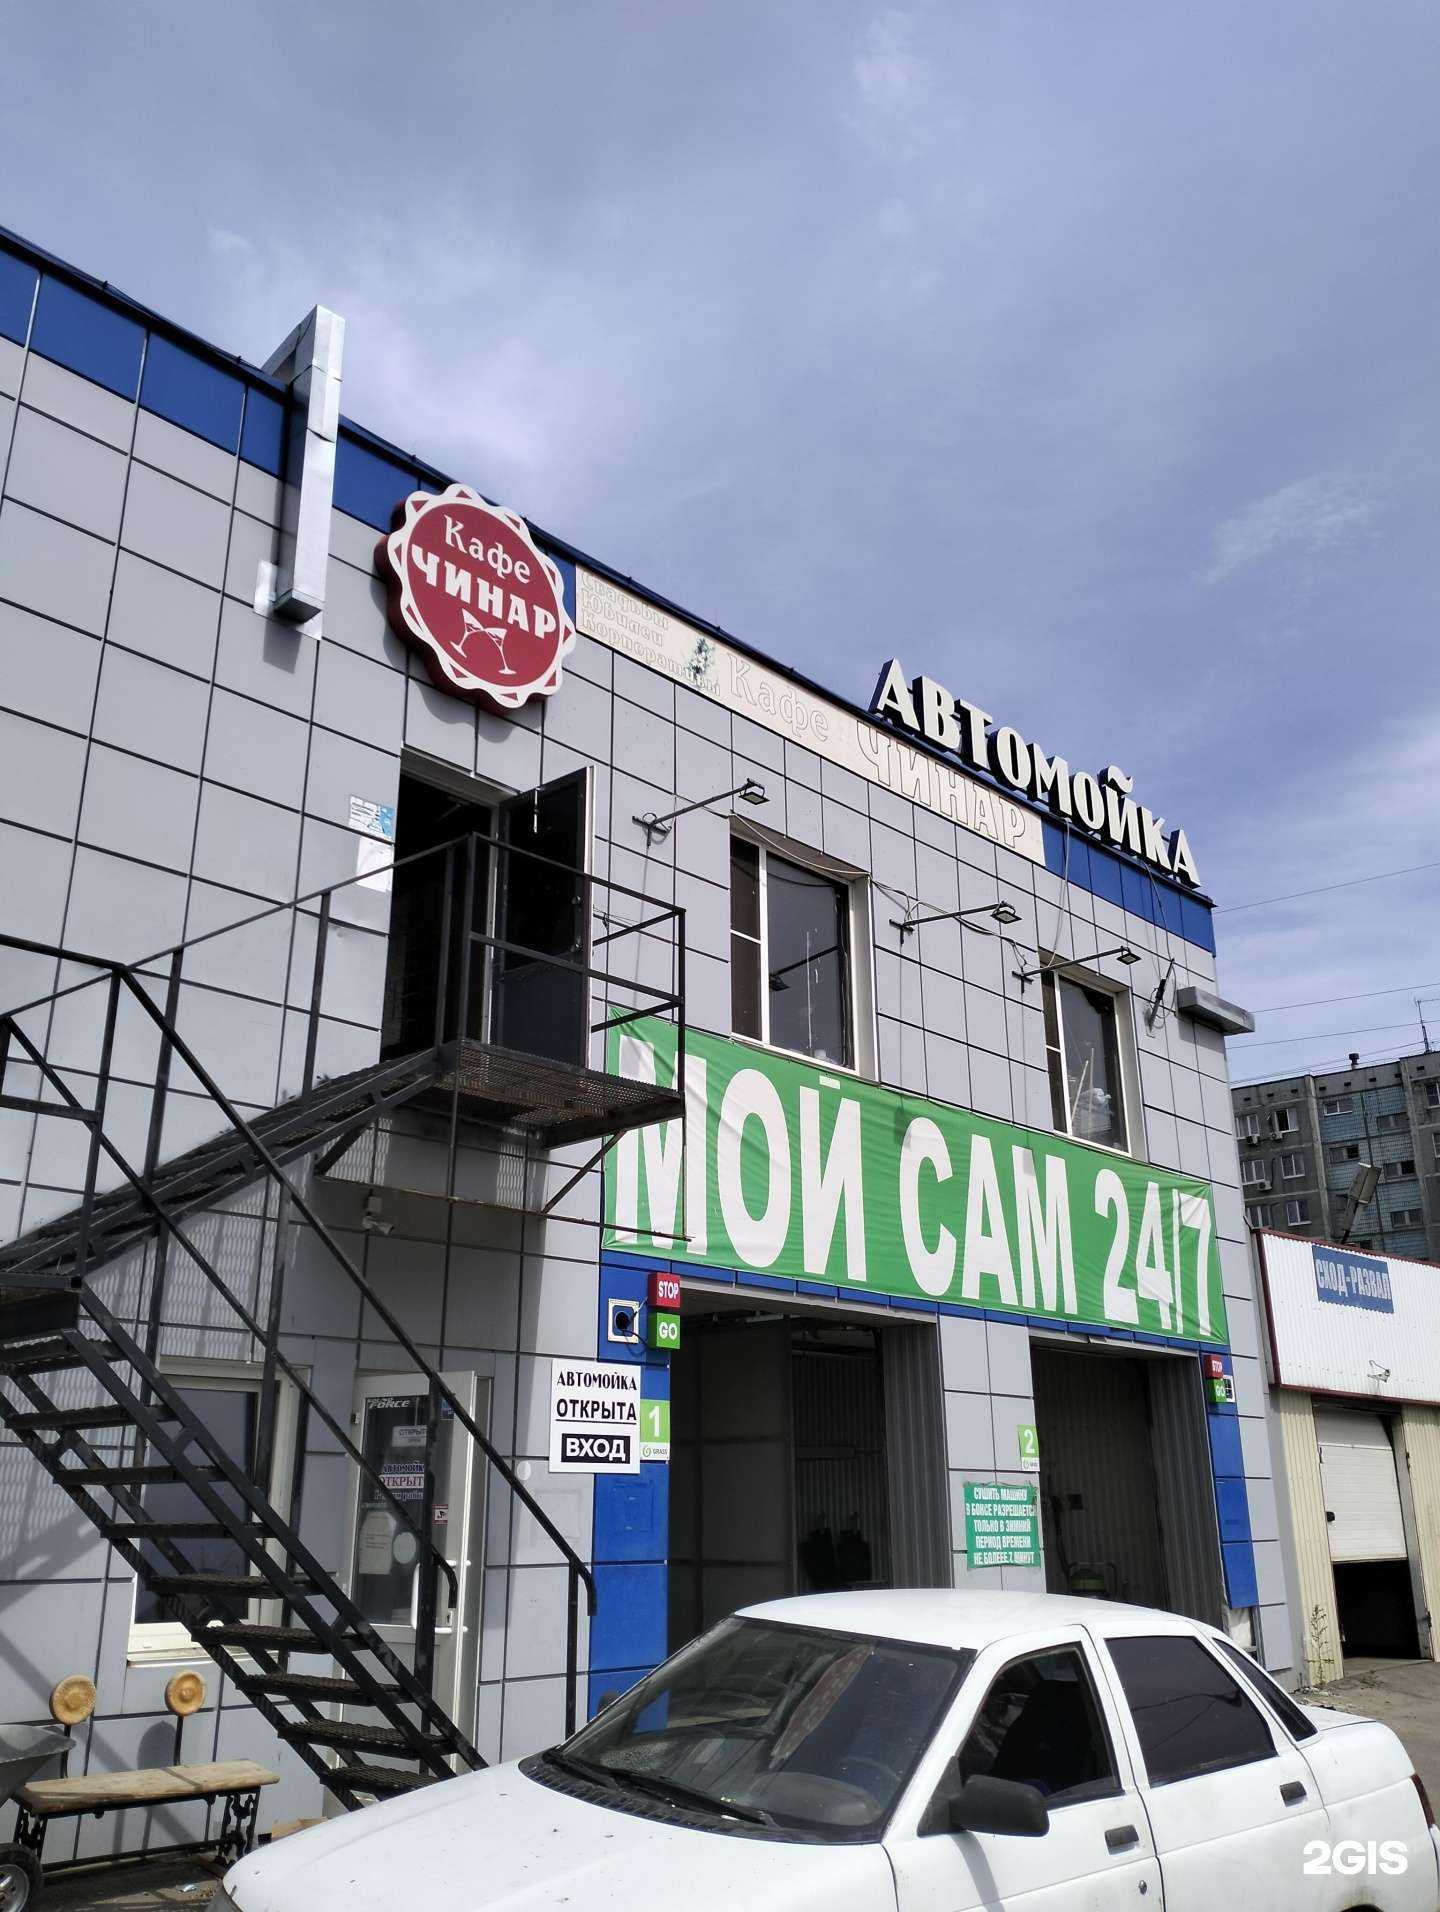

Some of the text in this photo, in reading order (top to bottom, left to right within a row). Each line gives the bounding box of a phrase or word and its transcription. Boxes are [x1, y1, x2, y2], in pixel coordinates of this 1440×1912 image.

[444, 513, 531, 584] Кафе
[411, 544, 557, 640] ЧИНАР
[727, 652, 1026, 848] Кафе ЧИНАР
[870, 657, 1201, 888] АВТОМОЙКА
[614, 1034, 1212, 1336] МОЙ САМ 24/7
[658, 1280, 679, 1299] STOP
[1315, 1259, 1392, 1300] СХОД-РАЗВАЛ
[659, 1321, 678, 1340] GO
[556, 1371, 638, 1391] АВТОМОЙКА
[1215, 1385, 1226, 1396] GO
[556, 1398, 637, 1421] ОТКРЫТА
[649, 1405, 660, 1437] 1
[566, 1437, 626, 1461] ВХОД
[1024, 1429, 1035, 1454] 2
[973, 1486, 1000, 1500] СУШИТЬ
[971, 1503, 993, 1516] БОКСЕ
[974, 1519, 999, 1532] ТОЛЬКО
[1000, 1519, 1005, 1532] В
[975, 1535, 1002, 1550] ПЕРИОД
[973, 1552, 983, 1566] НЕ
